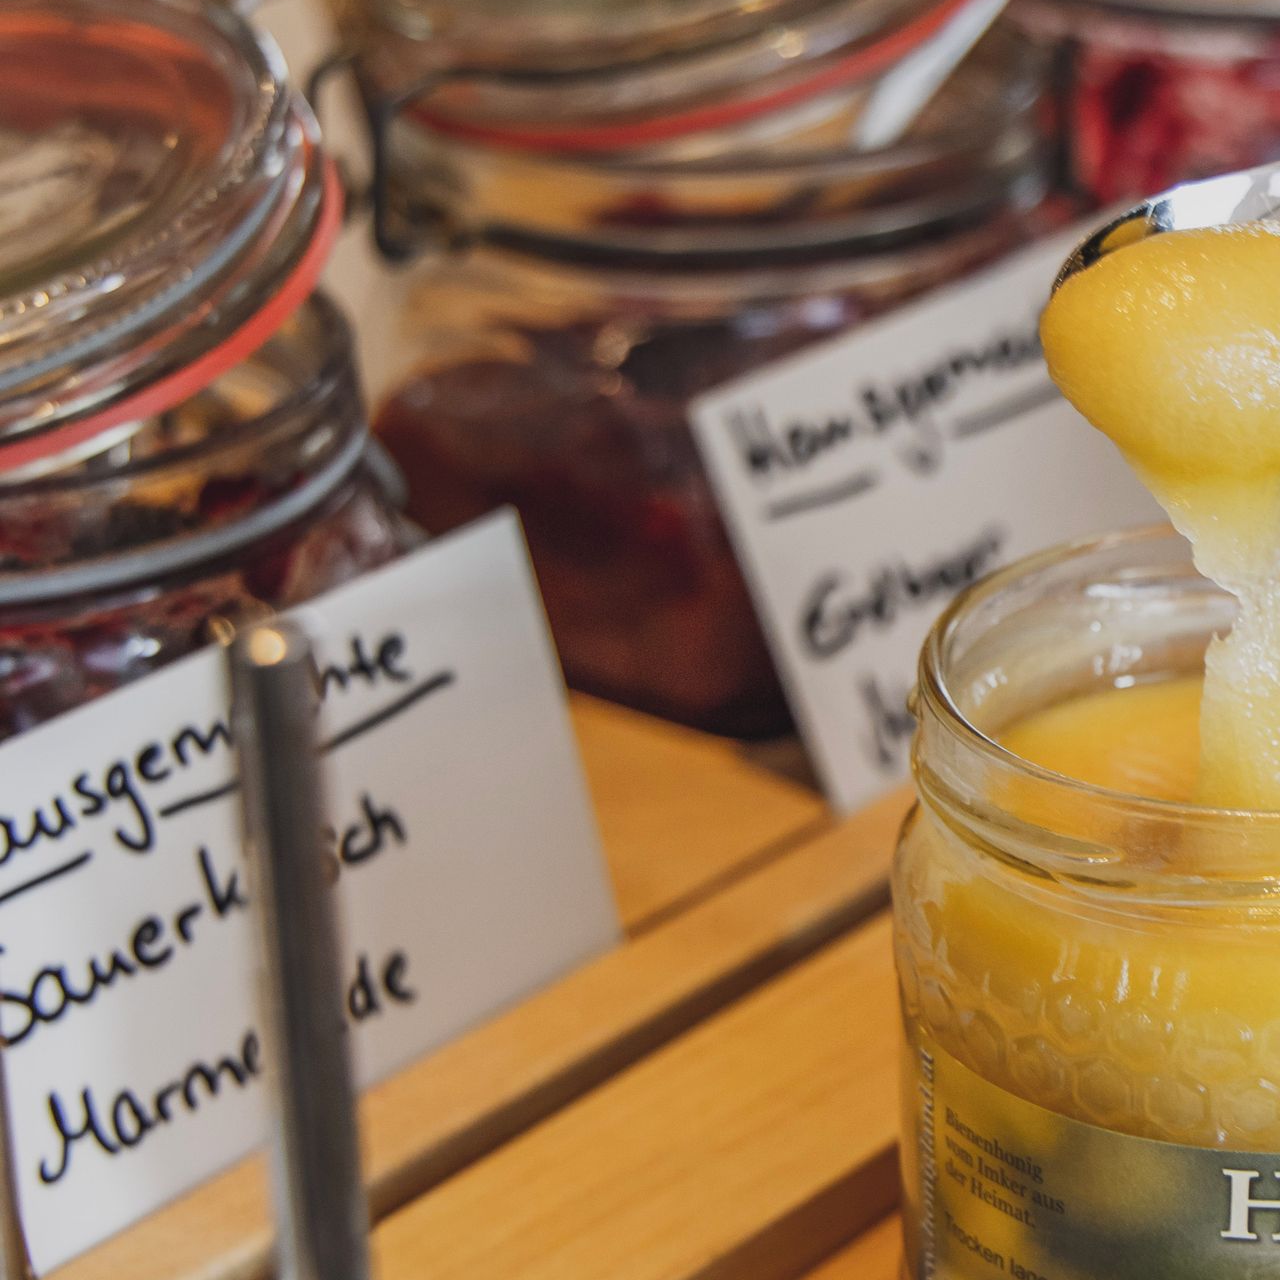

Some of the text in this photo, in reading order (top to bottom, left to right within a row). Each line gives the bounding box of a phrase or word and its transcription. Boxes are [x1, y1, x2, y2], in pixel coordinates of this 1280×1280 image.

[38, 950, 416, 1185] Marmede
[944, 1106, 1044, 1185] Bienenhonig
[977, 1155, 1027, 1198] Imker
[1031, 1190, 1066, 1214] aus
[944, 1210, 1005, 1272] Trocken
